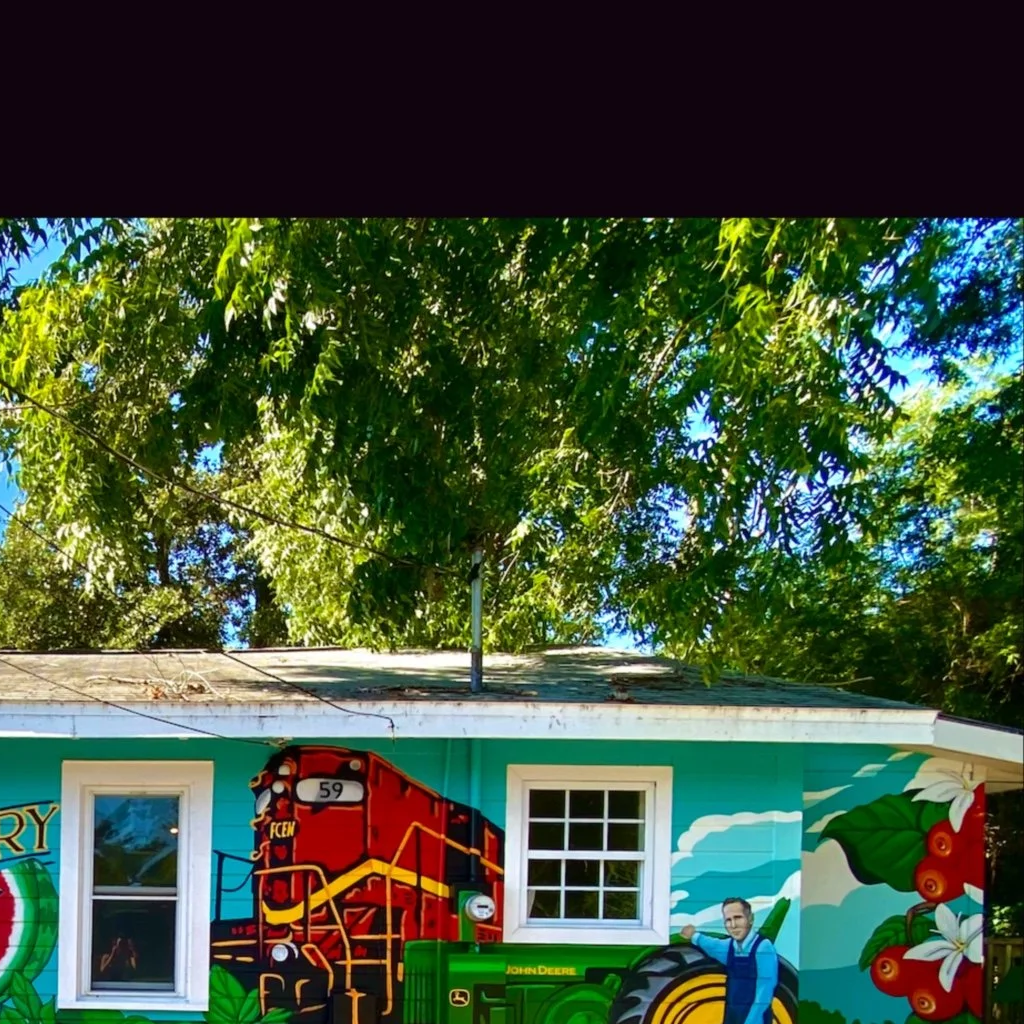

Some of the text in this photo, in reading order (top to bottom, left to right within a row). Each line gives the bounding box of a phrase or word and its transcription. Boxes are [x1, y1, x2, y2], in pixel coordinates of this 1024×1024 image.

[319, 781, 343, 799] 59
[505, 964, 577, 976] JOHN DEERE
